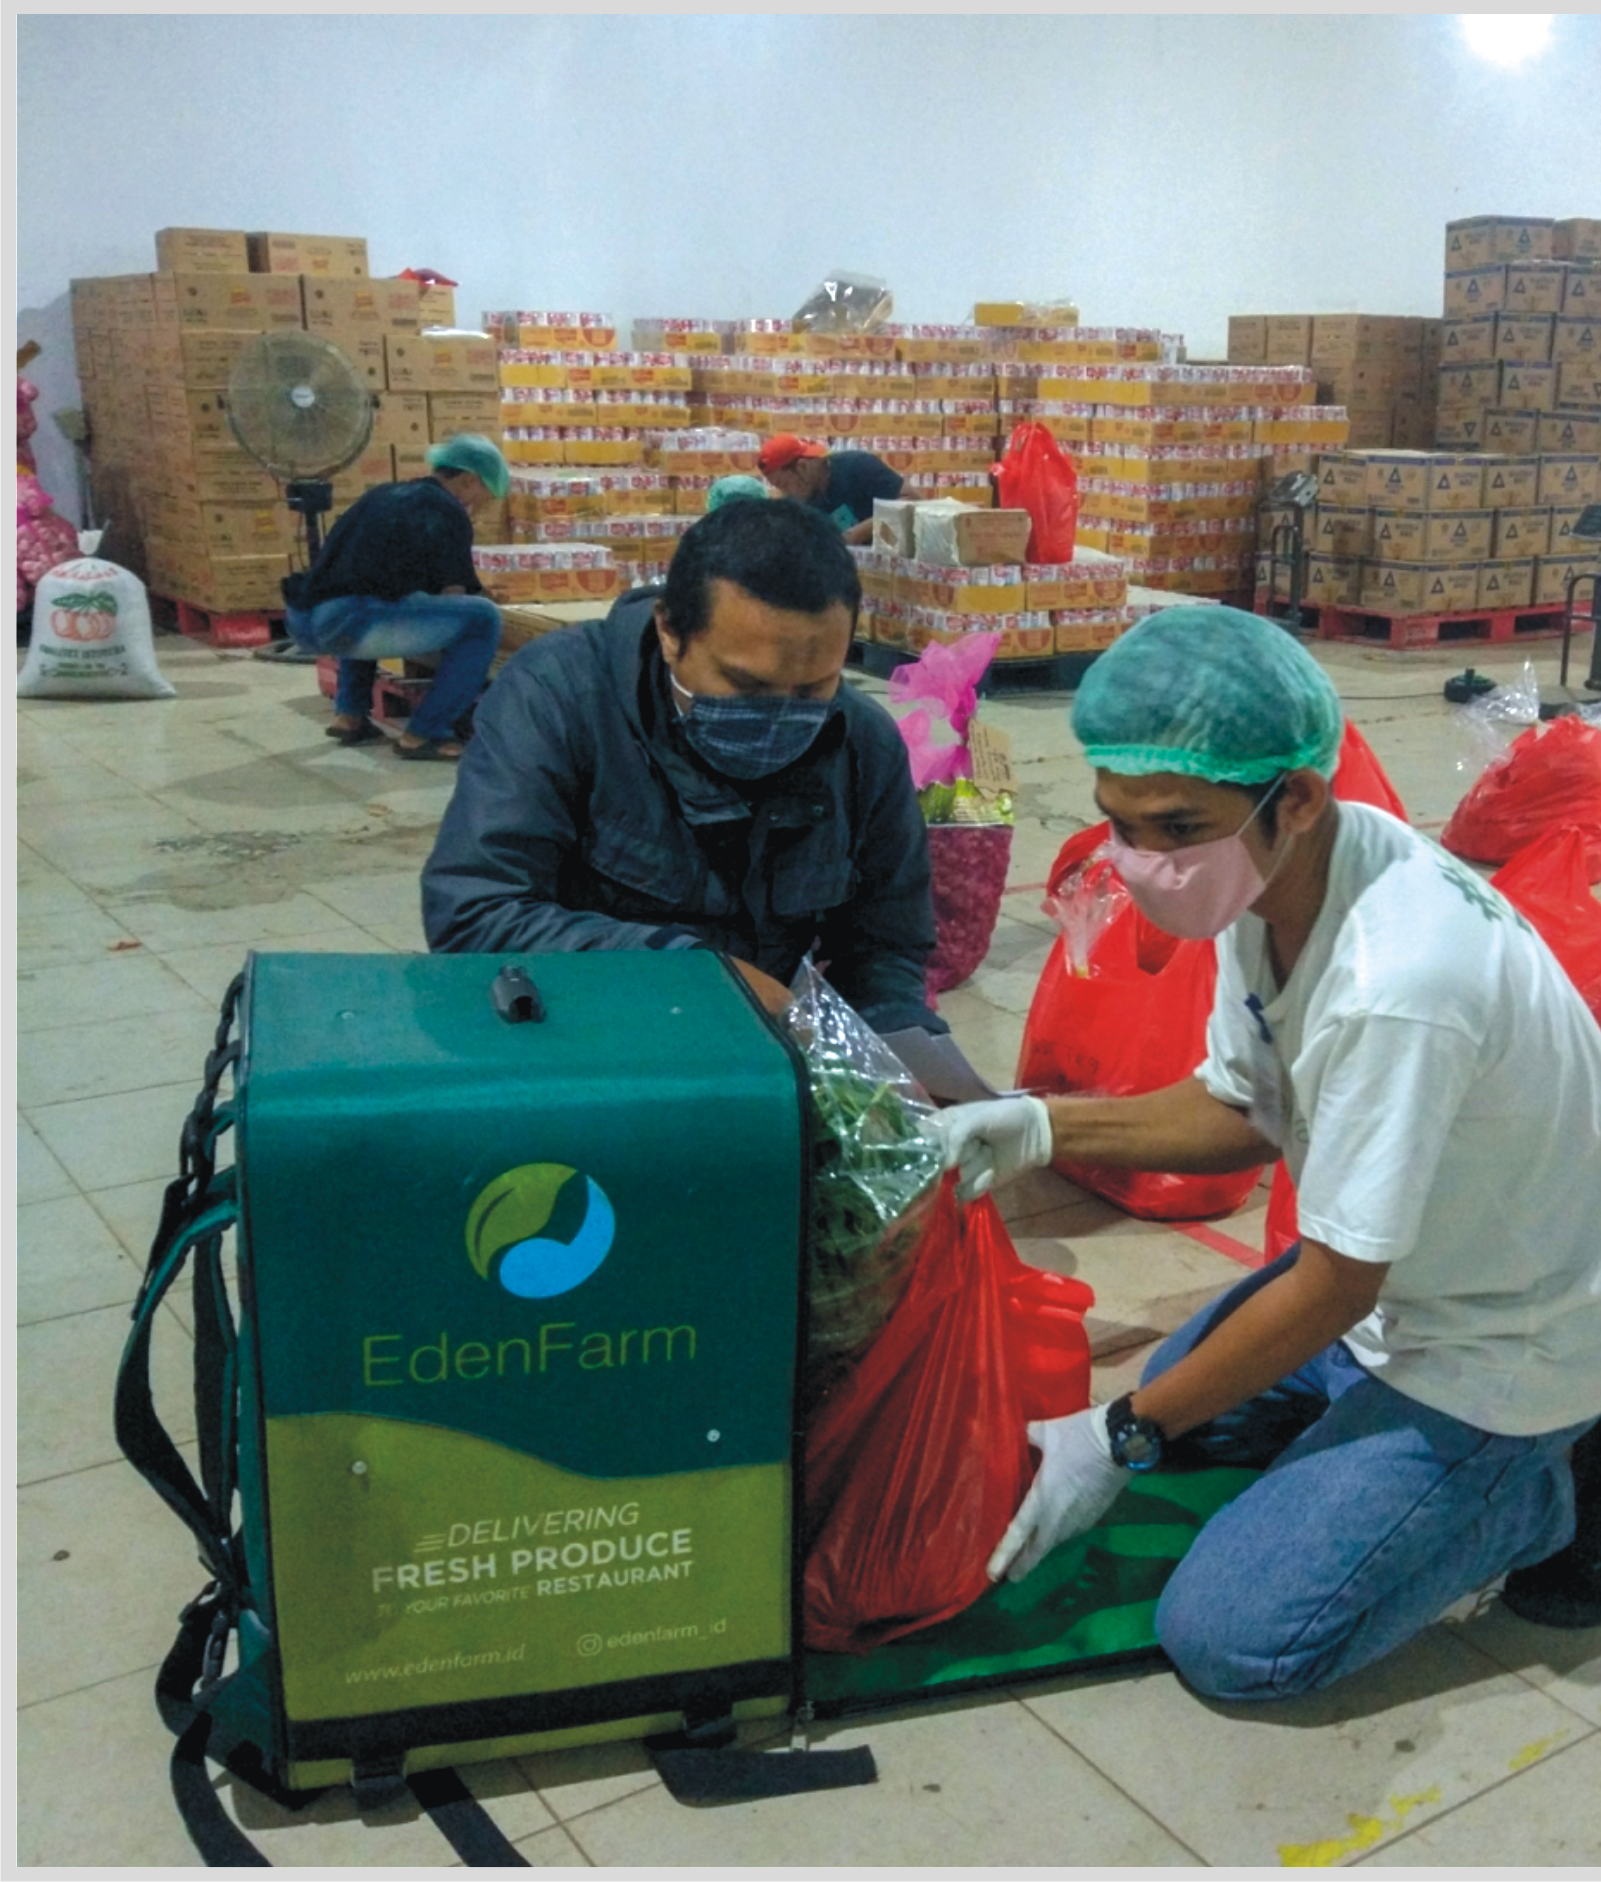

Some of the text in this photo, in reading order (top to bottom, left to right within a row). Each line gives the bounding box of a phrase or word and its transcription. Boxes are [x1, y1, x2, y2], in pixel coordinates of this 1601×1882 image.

[363, 1321, 697, 1386] EdenFarm
[447, 1502, 640, 1548] DELIVERING
[372, 1528, 693, 1593] FRESH PRODUCE
[405, 1596, 449, 1615] YOUR
[453, 1586, 530, 1608] FAVORITE
[537, 1560, 694, 1596] RESTAURANT
[606, 1618, 728, 1649] edenfarm_id
[344, 1643, 527, 1684] www.edenfarm.id
